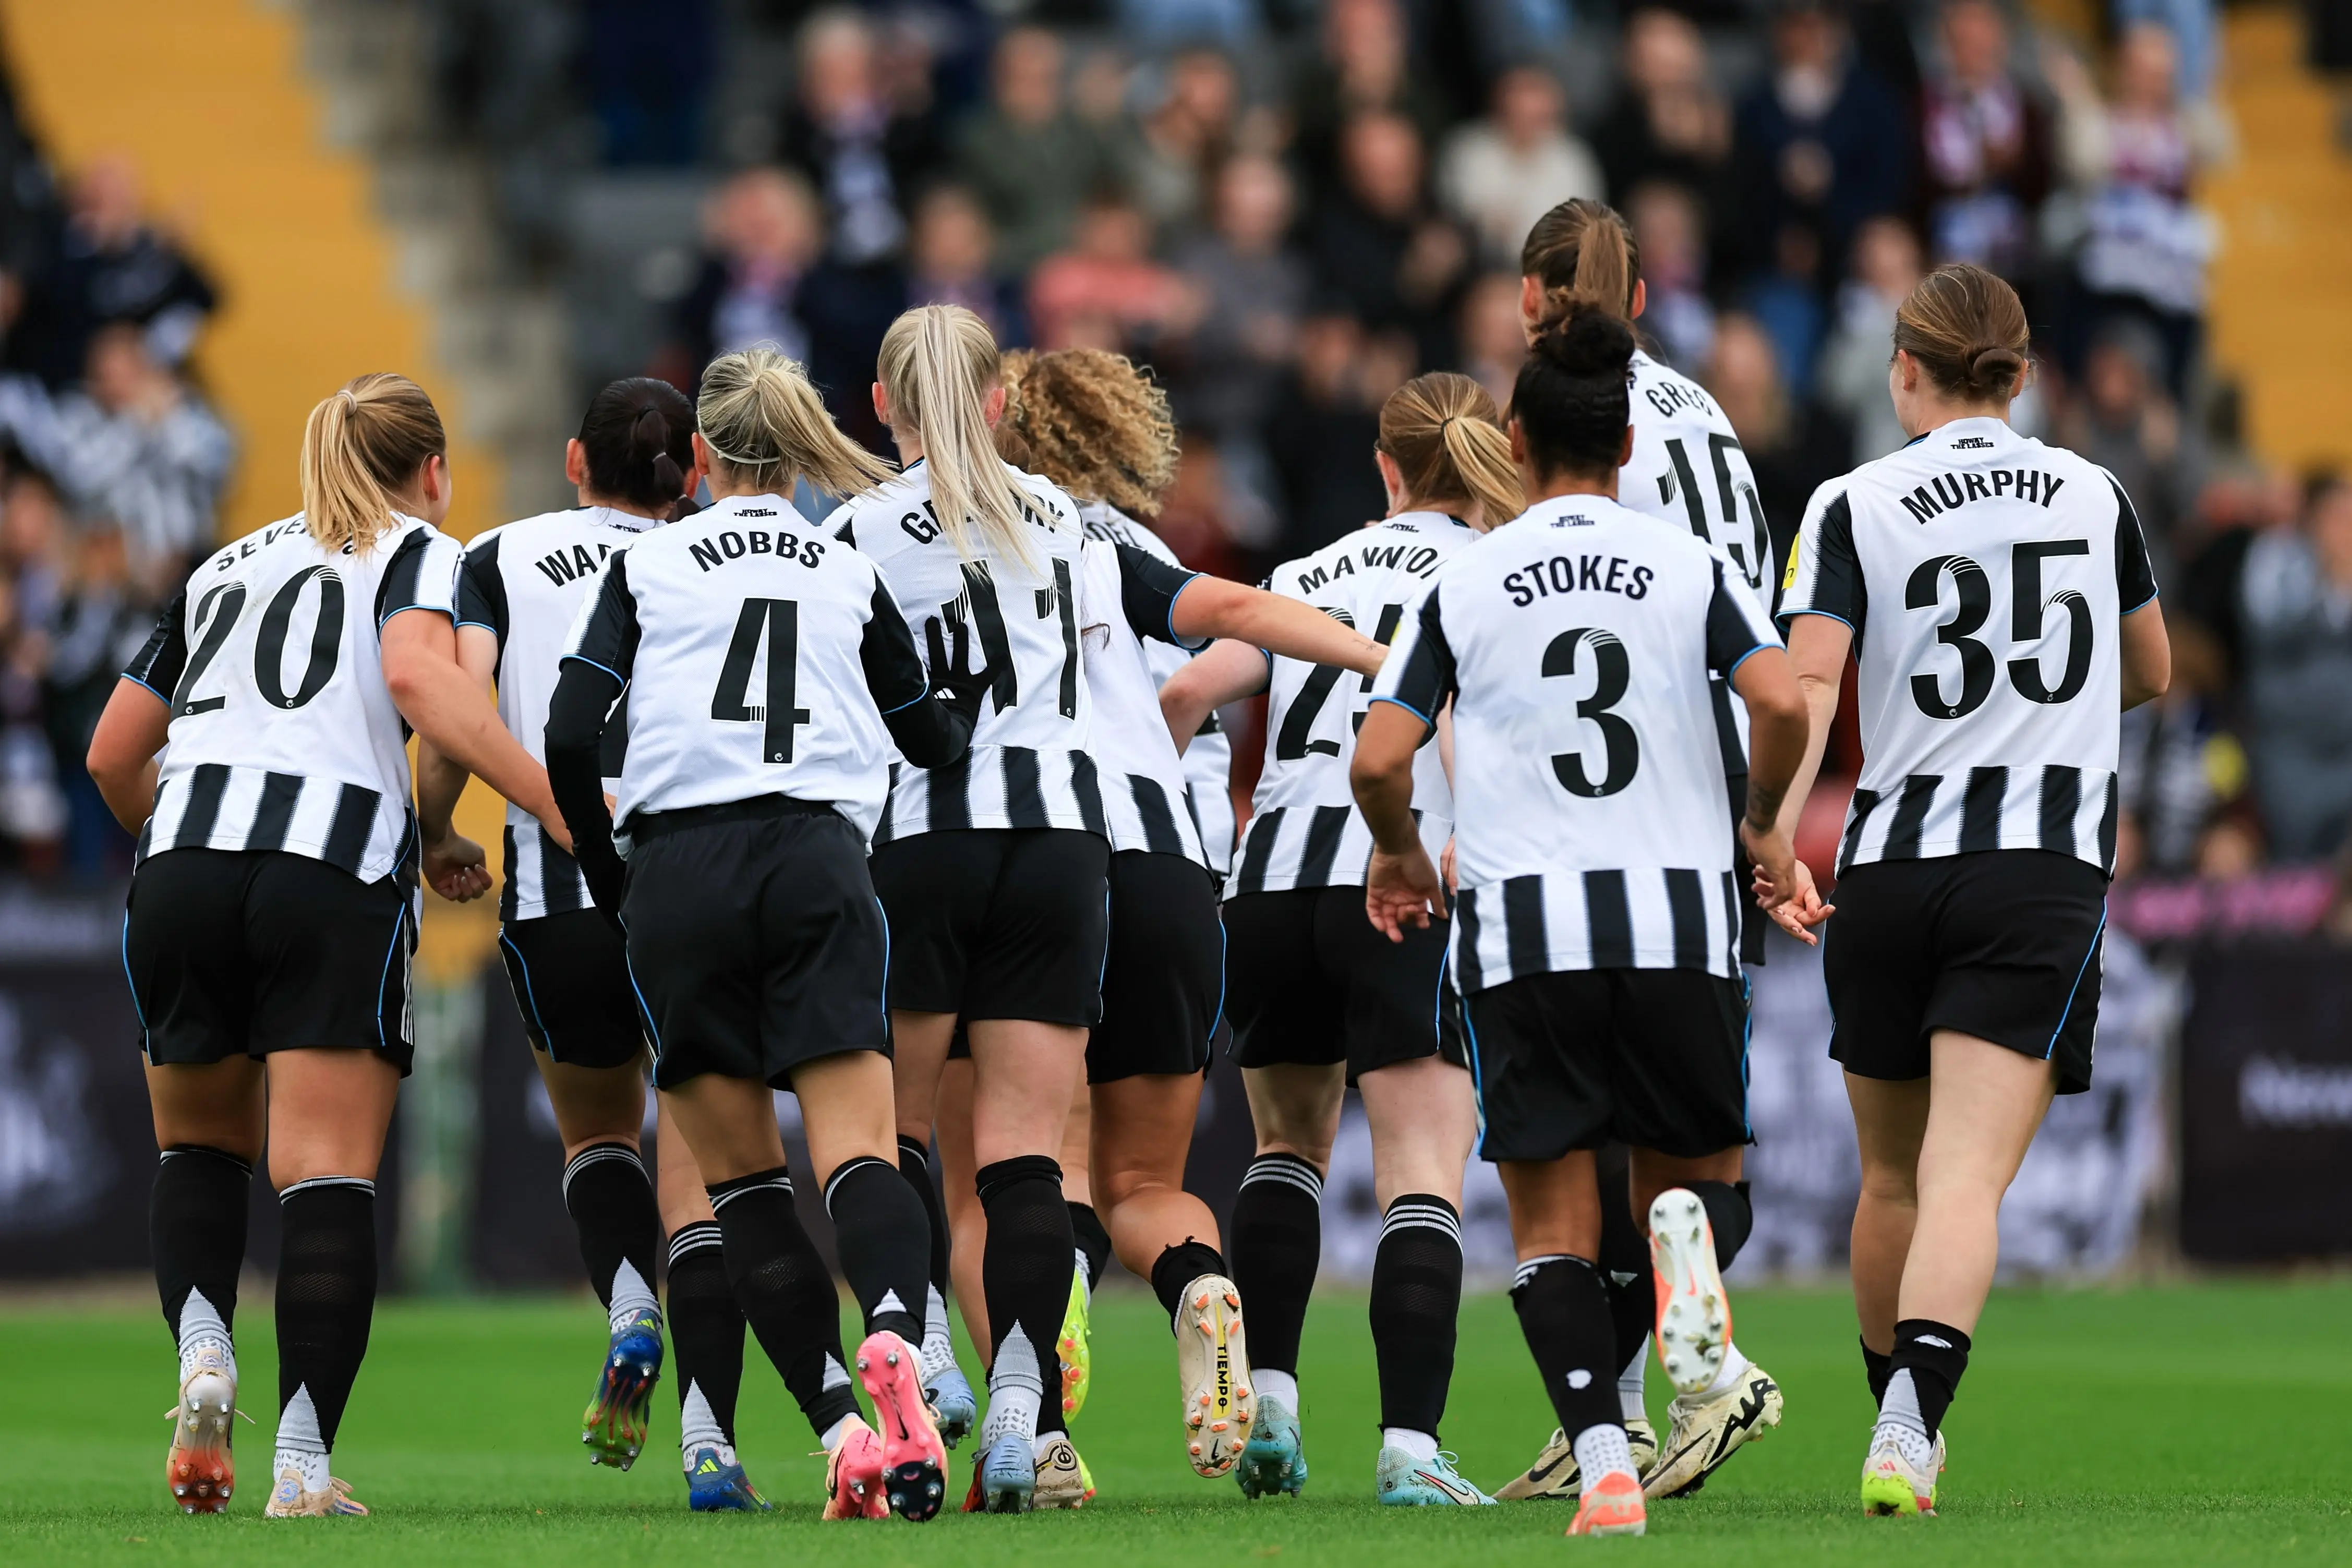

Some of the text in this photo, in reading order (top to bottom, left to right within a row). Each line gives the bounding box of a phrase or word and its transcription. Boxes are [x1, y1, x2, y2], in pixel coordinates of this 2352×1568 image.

[688, 531, 825, 573] NOBBS
[1656, 432, 1768, 589] 15
[1899, 469, 2065, 525] MURPHY
[171, 564, 345, 717] 20
[1504, 555, 1654, 607] STOKES
[1904, 538, 2094, 721] 35
[710, 597, 811, 764] 4
[1541, 628, 1639, 799] 3
